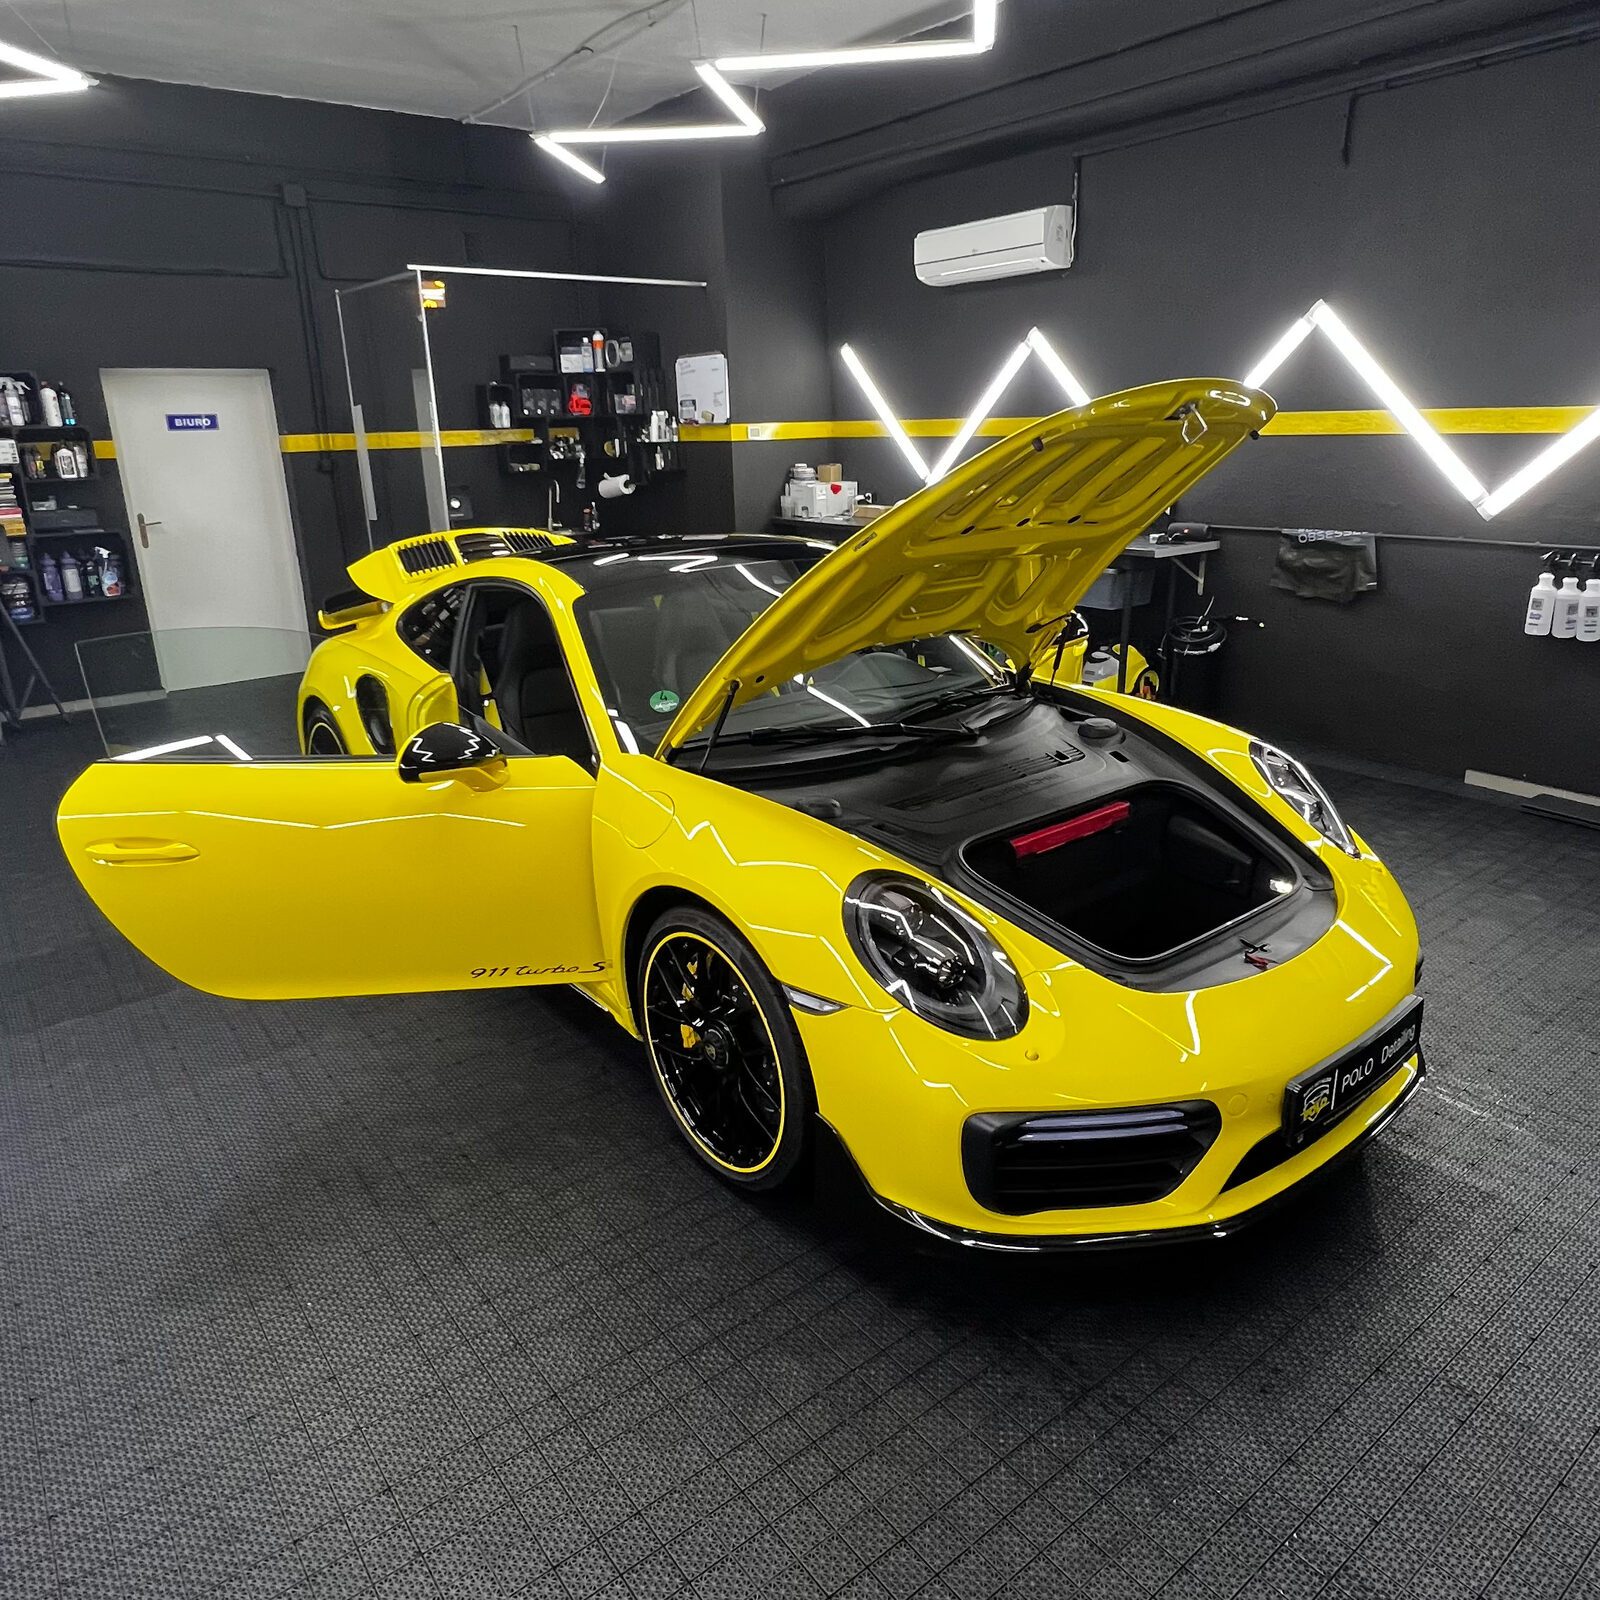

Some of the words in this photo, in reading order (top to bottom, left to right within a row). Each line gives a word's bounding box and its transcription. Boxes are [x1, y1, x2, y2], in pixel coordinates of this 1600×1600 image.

[174, 418, 211, 427] BIURO
[470, 967, 509, 978] 911
[515, 964, 578, 975] turbo
[578, 961, 606, 974] S
[1341, 1057, 1374, 1093] POLO
